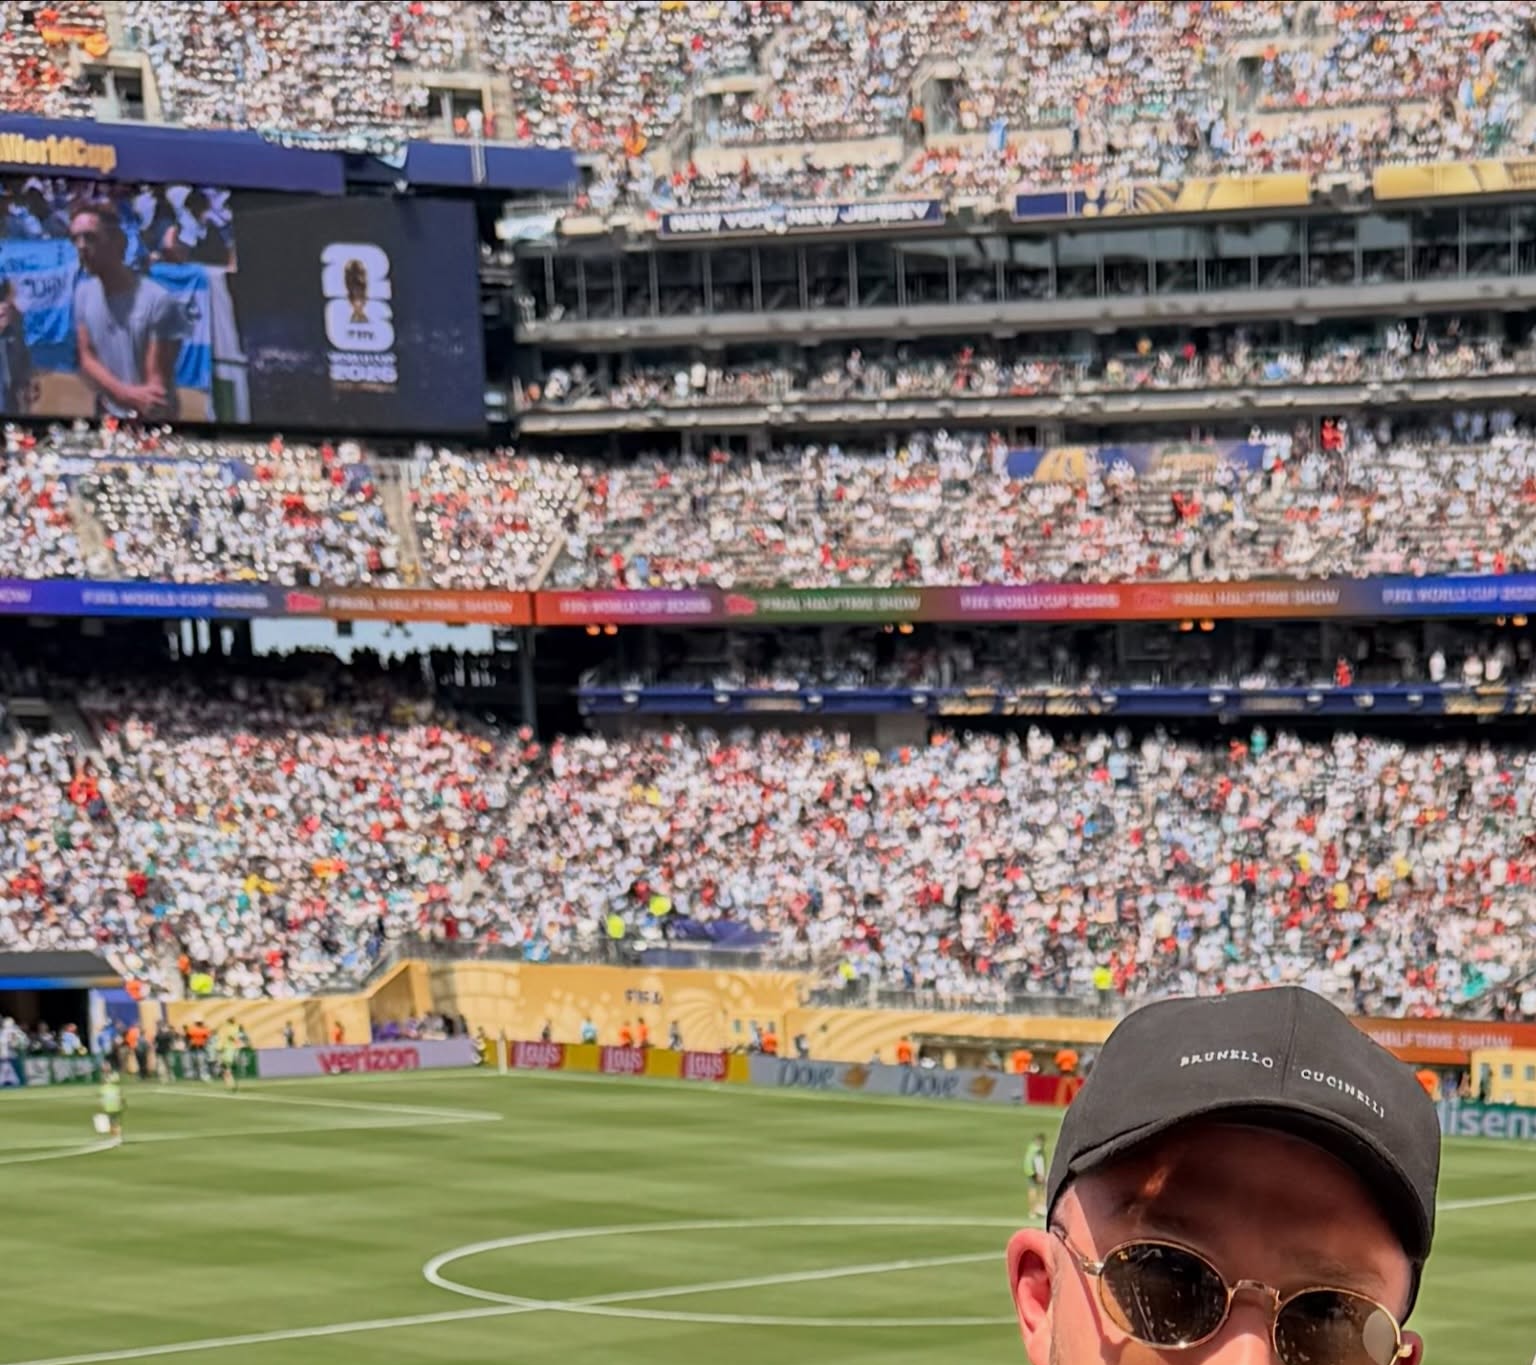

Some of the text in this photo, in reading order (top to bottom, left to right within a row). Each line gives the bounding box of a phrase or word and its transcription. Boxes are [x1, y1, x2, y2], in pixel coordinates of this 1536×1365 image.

[317, 1046, 419, 1074] verizon
[778, 1060, 835, 1090] Dove
[900, 1069, 960, 1098] Dove
[1180, 1049, 1385, 1119] BRUNELLO CUCINELLI
